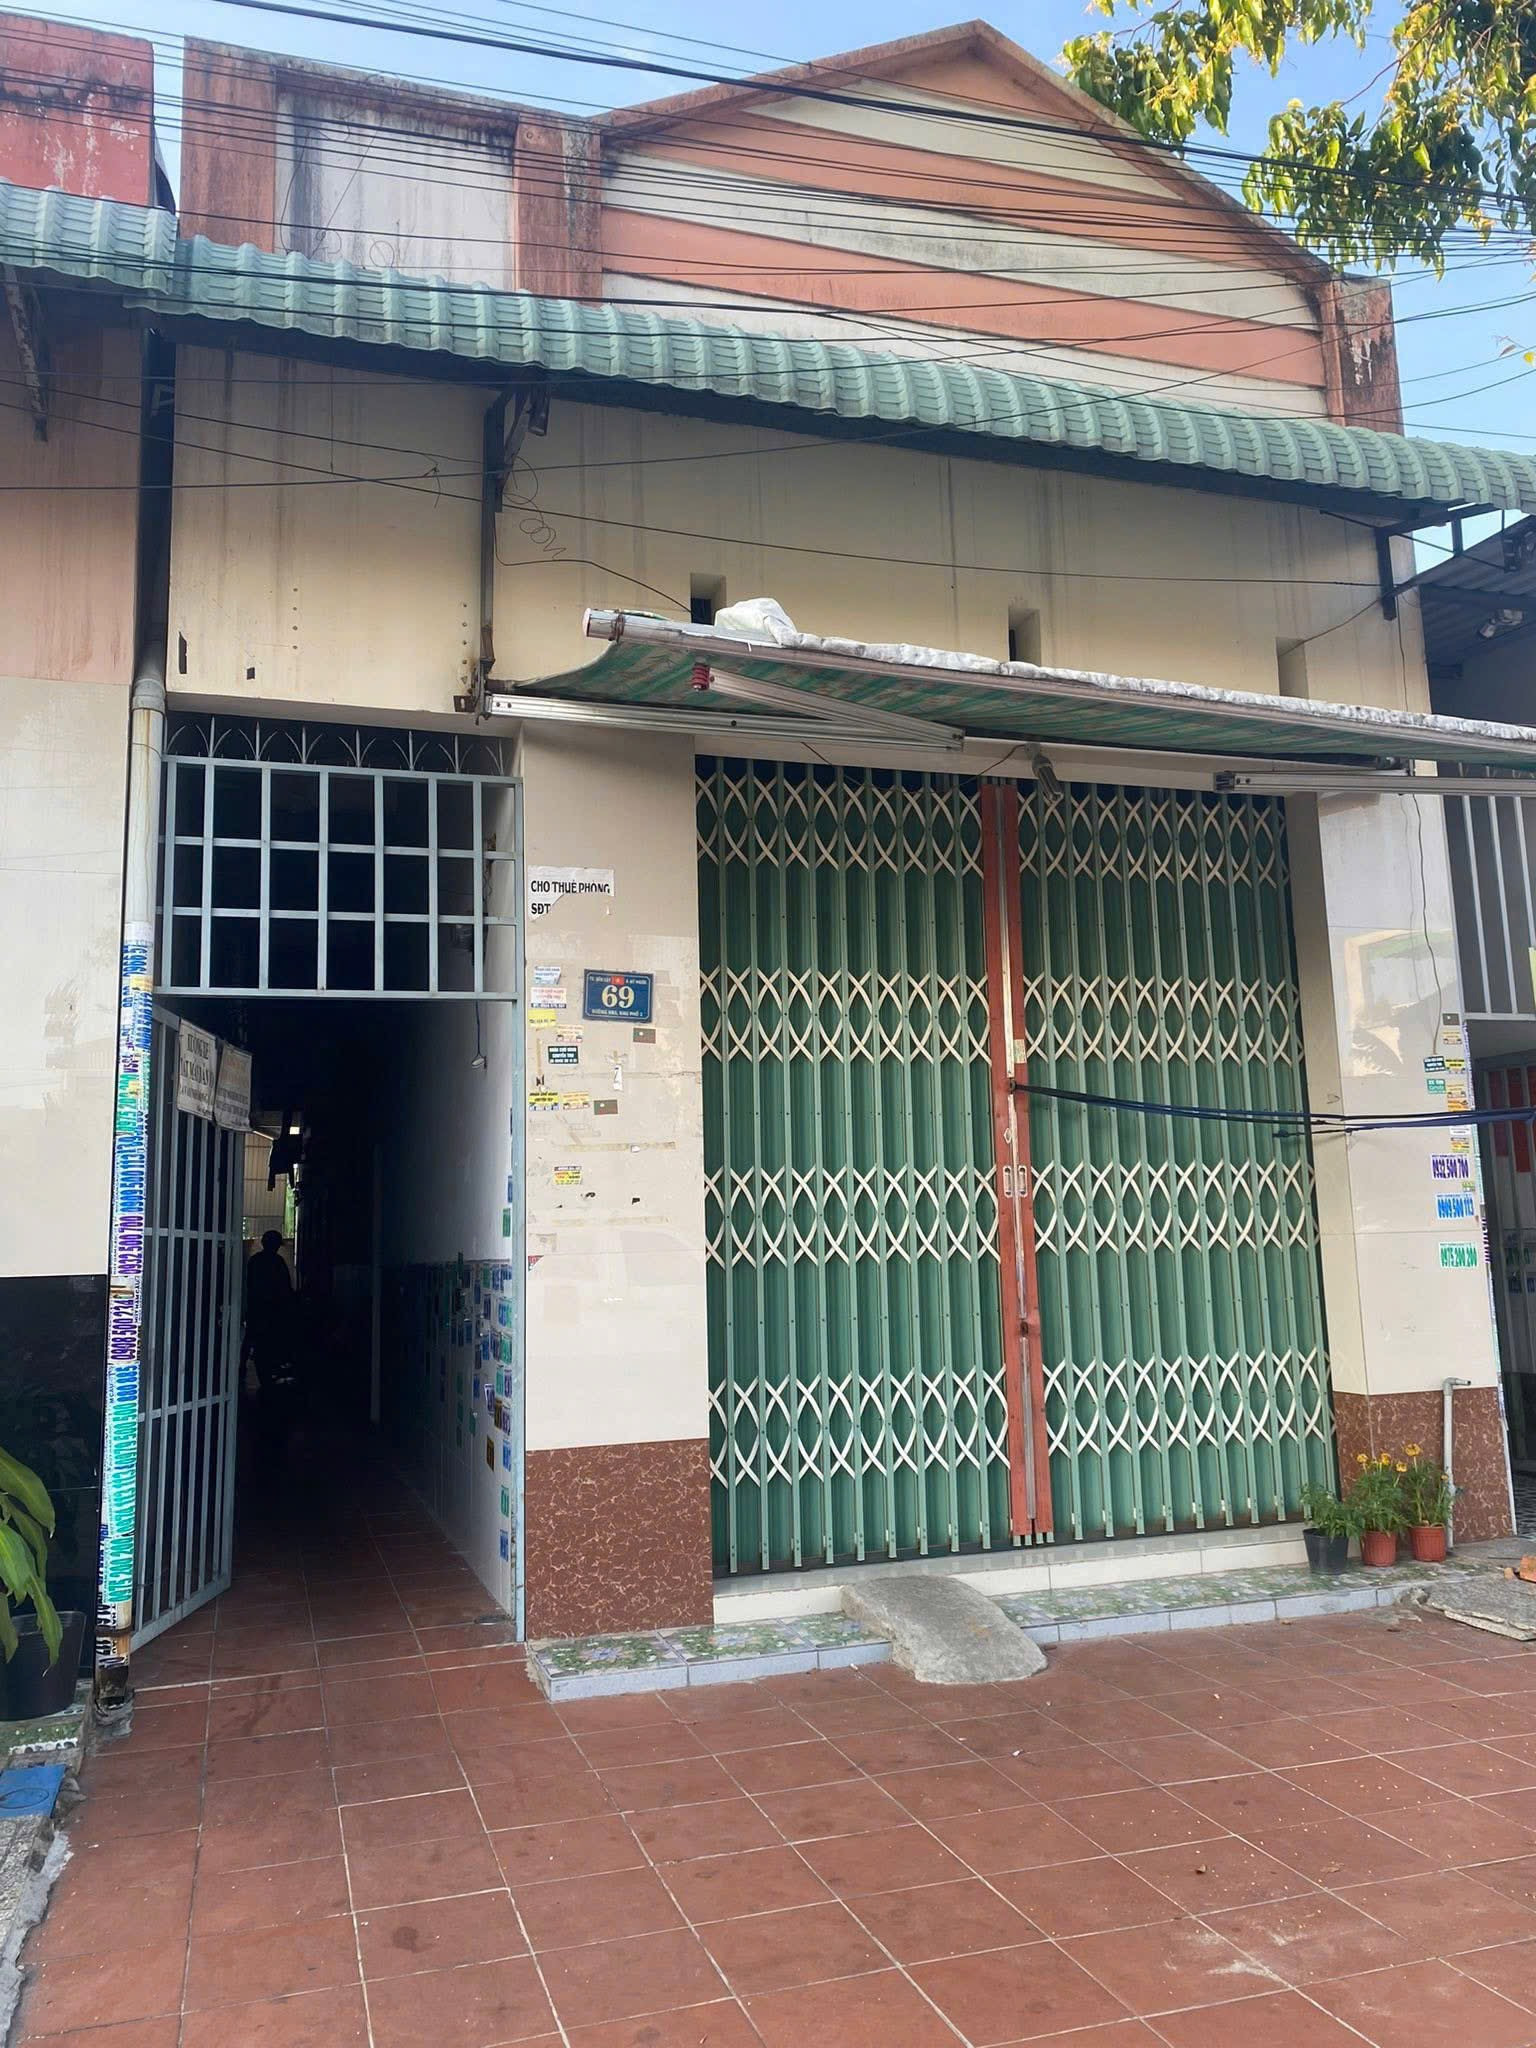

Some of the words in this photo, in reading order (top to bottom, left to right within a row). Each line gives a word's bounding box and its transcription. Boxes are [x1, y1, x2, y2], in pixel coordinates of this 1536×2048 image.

[530, 880, 550, 893] CHO
[530, 902, 551, 915] SĐT
[602, 984, 634, 1008] 69
[120, 1170, 144, 1188] 500
[120, 1190, 143, 1212] 0909
[119, 1216, 143, 1232] 700
[119, 1234, 142, 1251] 500
[118, 1253, 142, 1274] 0932
[112, 1318, 137, 1335] 500
[115, 1365, 137, 1383] 885
[116, 1385, 137, 1402] 880
[112, 1403, 136, 1422] 500
[113, 1422, 136, 1441] 500
[110, 1537, 133, 1557] 200
[109, 1558, 132, 1577] 200
[108, 1578, 132, 1602] 0975
